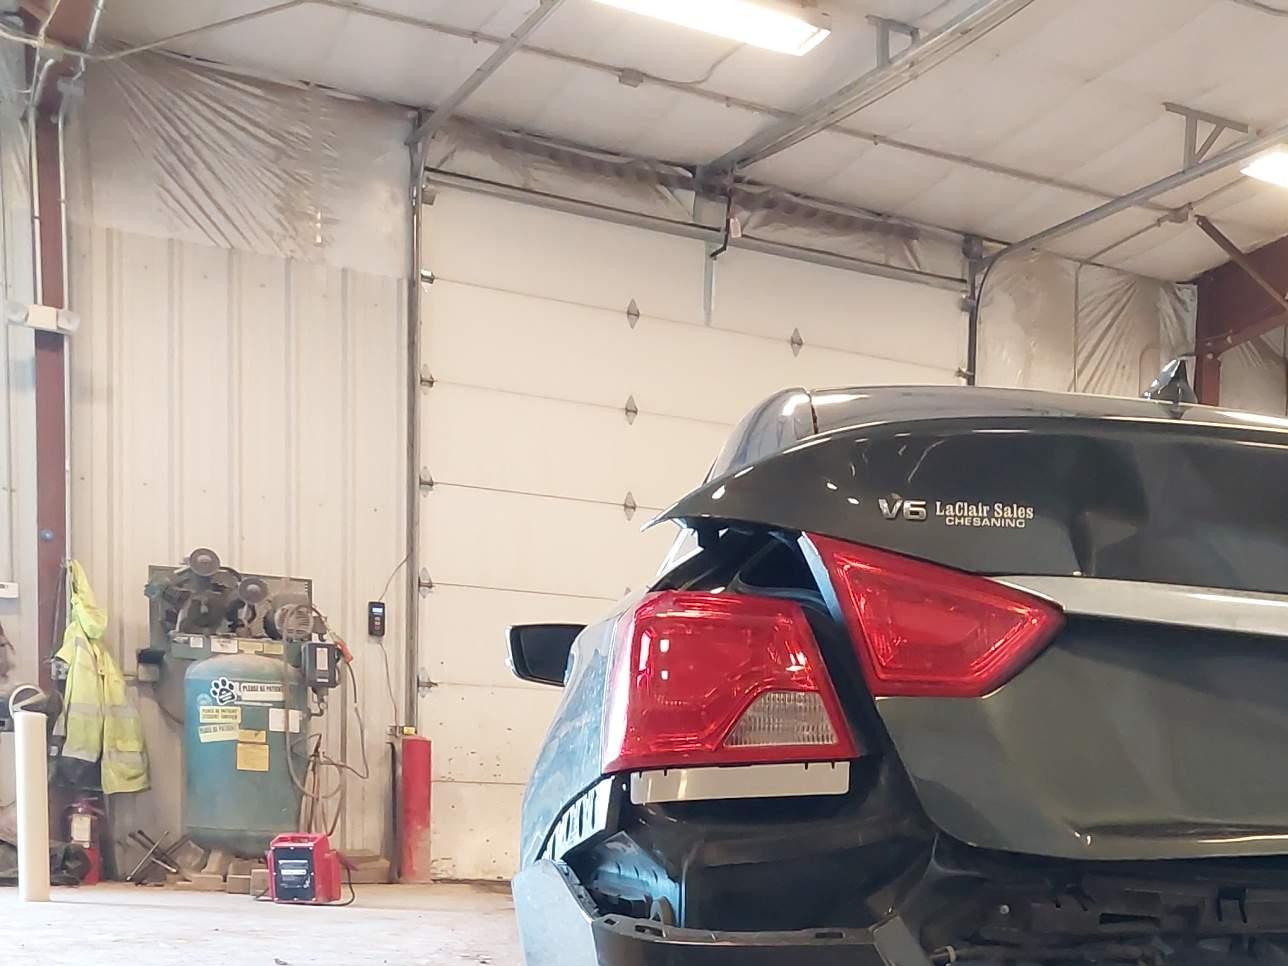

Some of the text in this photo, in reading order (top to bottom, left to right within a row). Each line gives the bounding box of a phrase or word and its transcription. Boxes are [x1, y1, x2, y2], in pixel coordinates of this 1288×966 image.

[878, 498, 927, 520] V6
[935, 501, 1034, 519] LaClair Sales
[945, 517, 1026, 528] CHESANING
